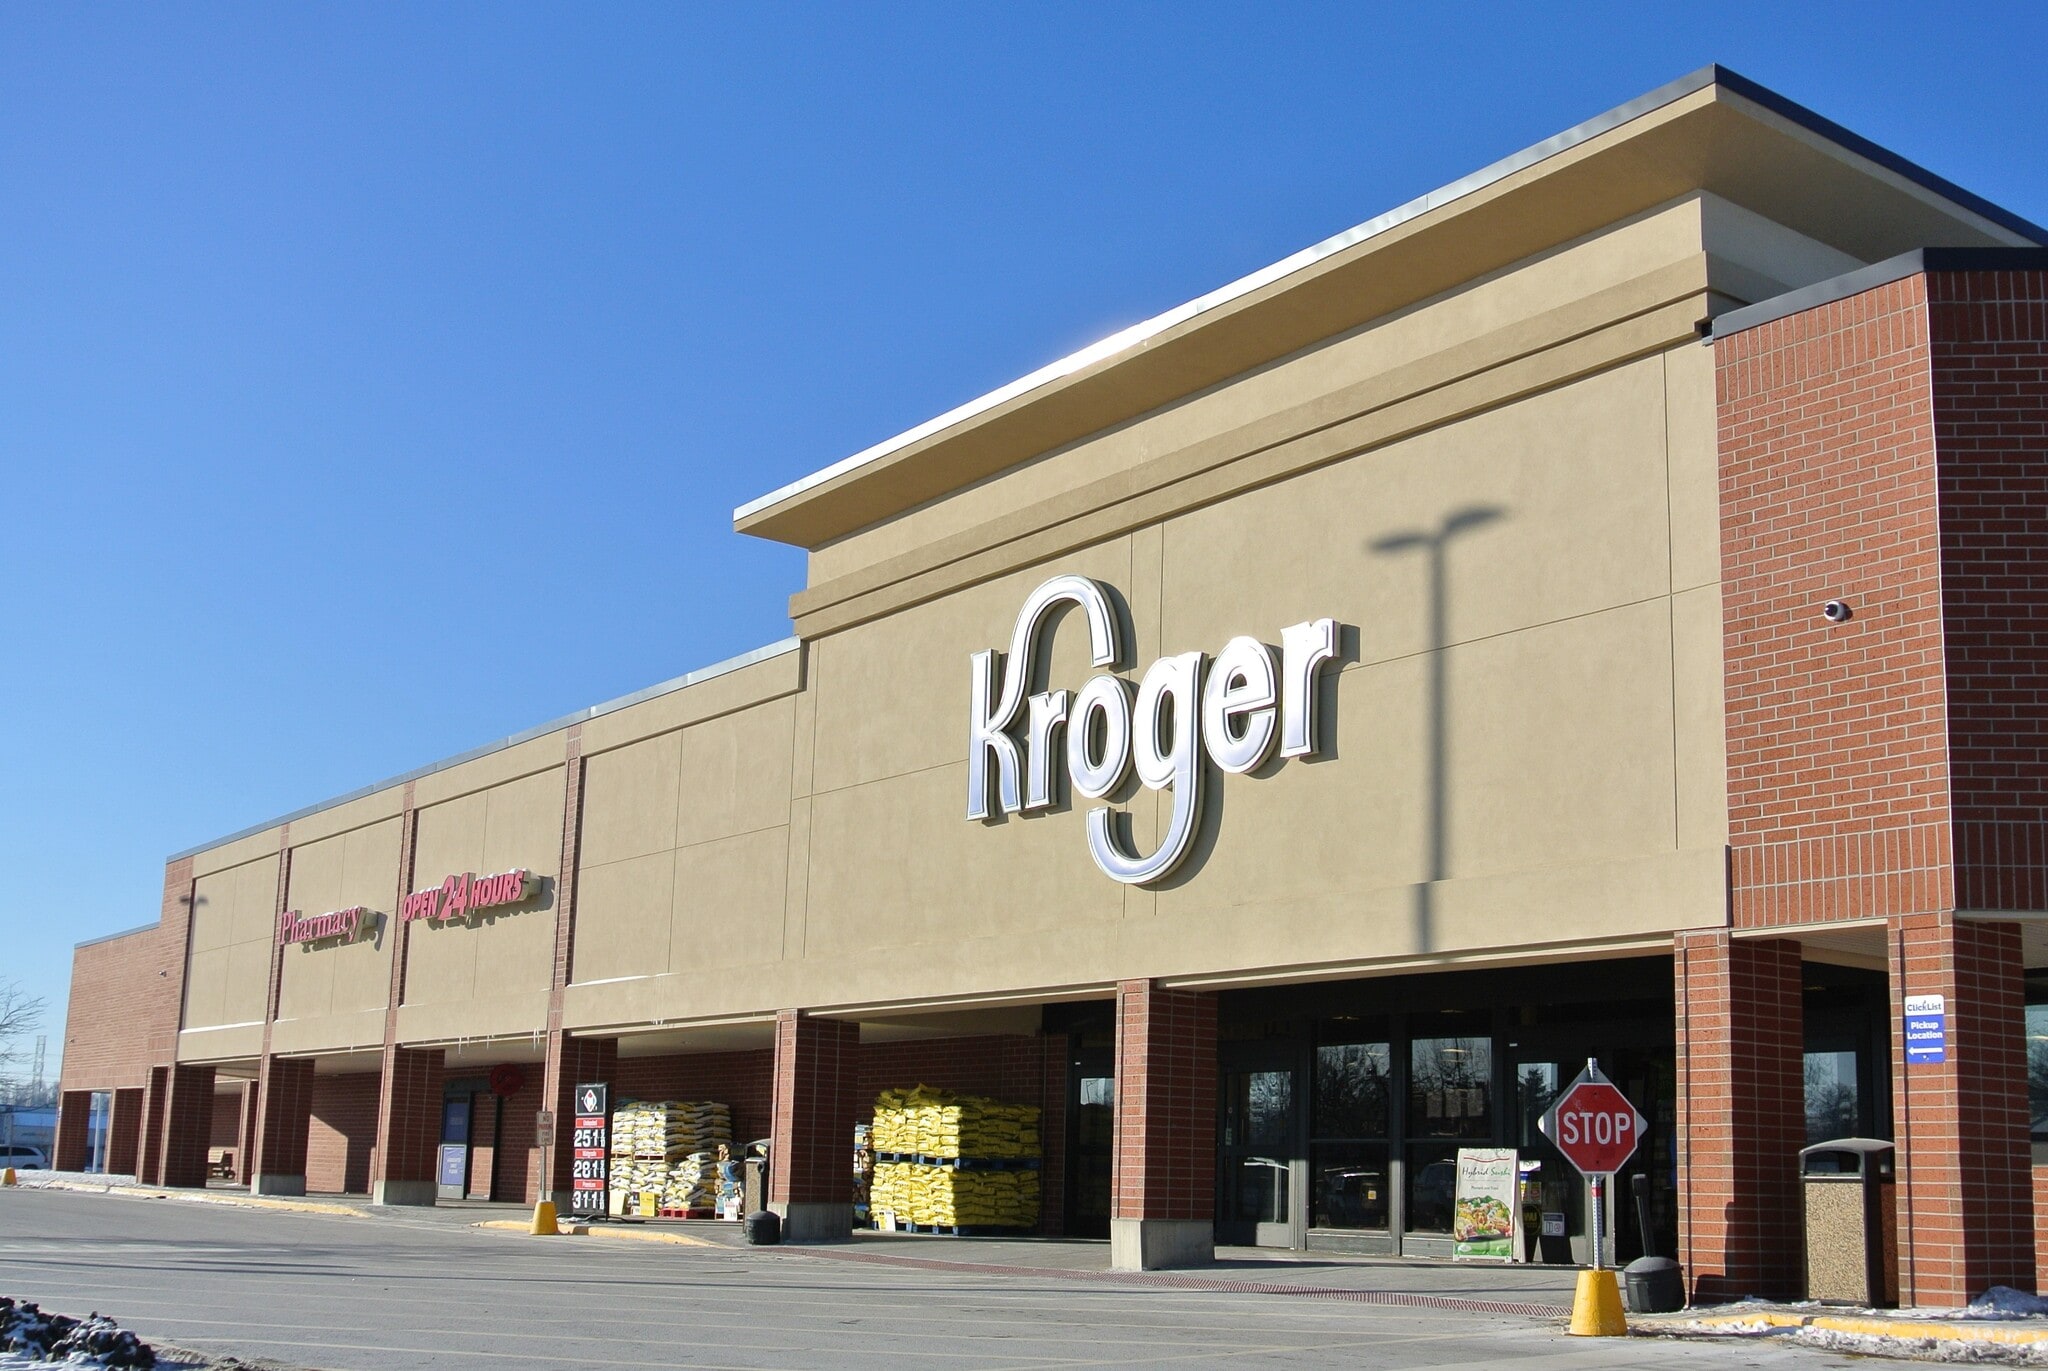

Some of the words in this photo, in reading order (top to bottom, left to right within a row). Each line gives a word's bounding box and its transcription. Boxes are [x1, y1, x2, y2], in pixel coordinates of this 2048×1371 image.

[966, 573, 1341, 885] Kroger
[403, 889, 439, 921] OPEN
[438, 872, 469, 920] 24
[470, 870, 524, 908] HOURS
[280, 906, 361, 946] Pharmacy
[1907, 1000, 1942, 1011] ClickList
[1907, 1031, 1943, 1040] Location
[1911, 1021, 1939, 1030] Pickup
[1562, 1111, 1631, 1145] STOP
[1462, 1168, 1489, 1179] Hybrid
[1490, 1168, 1512, 1177] Sushi
